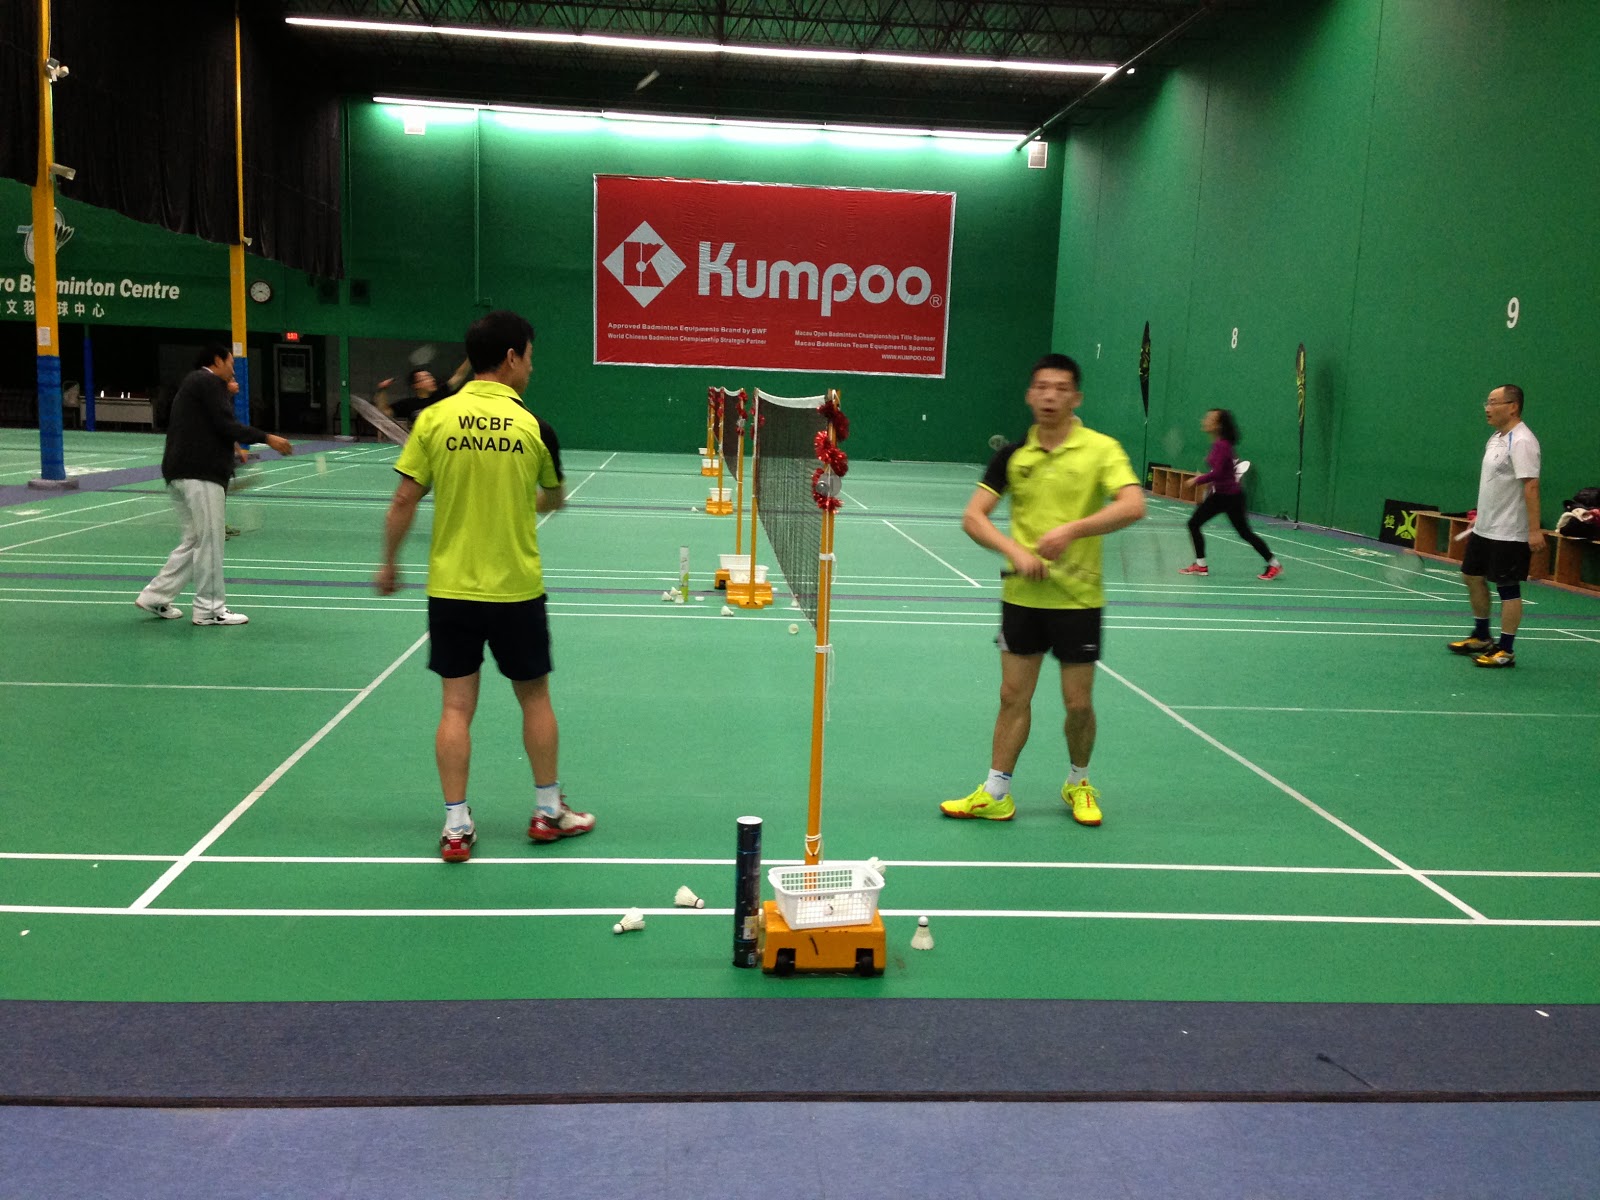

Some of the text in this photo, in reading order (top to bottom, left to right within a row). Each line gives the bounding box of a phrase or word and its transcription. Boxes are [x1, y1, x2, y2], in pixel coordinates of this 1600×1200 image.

[20, 274, 115, 296] Bminton
[120, 279, 180, 299] Centre
[698, 241, 932, 317] Kumpoo
[6, 299, 105, 317] 文羽球中心
[1507, 297, 1519, 329] 9
[720, 337, 745, 345] Strategic
[913, 334, 935, 342] Sponsor
[1231, 327, 1238, 349] 8
[458, 416, 513, 431] WCBF
[446, 436, 524, 454] CANADA
